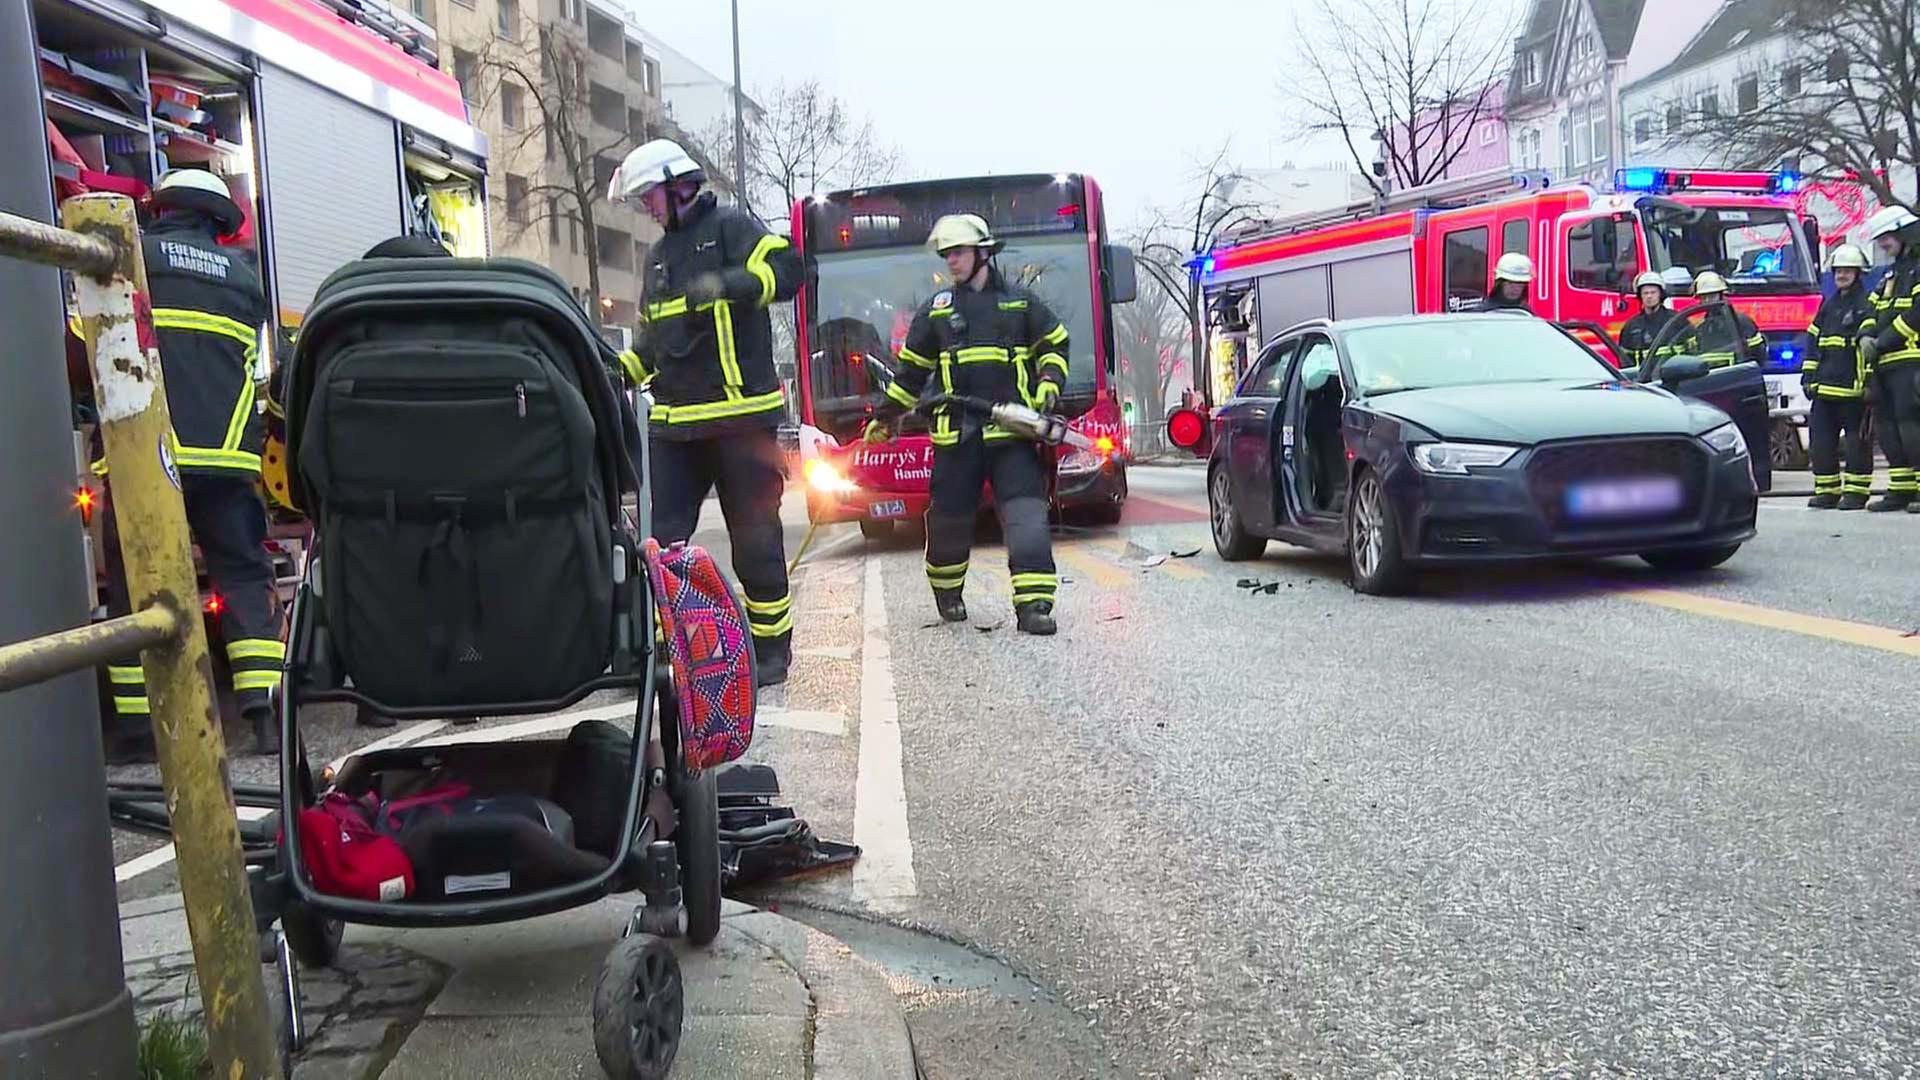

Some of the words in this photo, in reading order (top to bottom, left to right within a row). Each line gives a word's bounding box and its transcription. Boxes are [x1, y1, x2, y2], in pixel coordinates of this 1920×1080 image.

[160, 241, 231, 268] FEUERWEHR
[169, 255, 227, 279] HAMBURG
[853, 448, 917, 468] Harry's
[893, 466, 933, 481] Hamb
